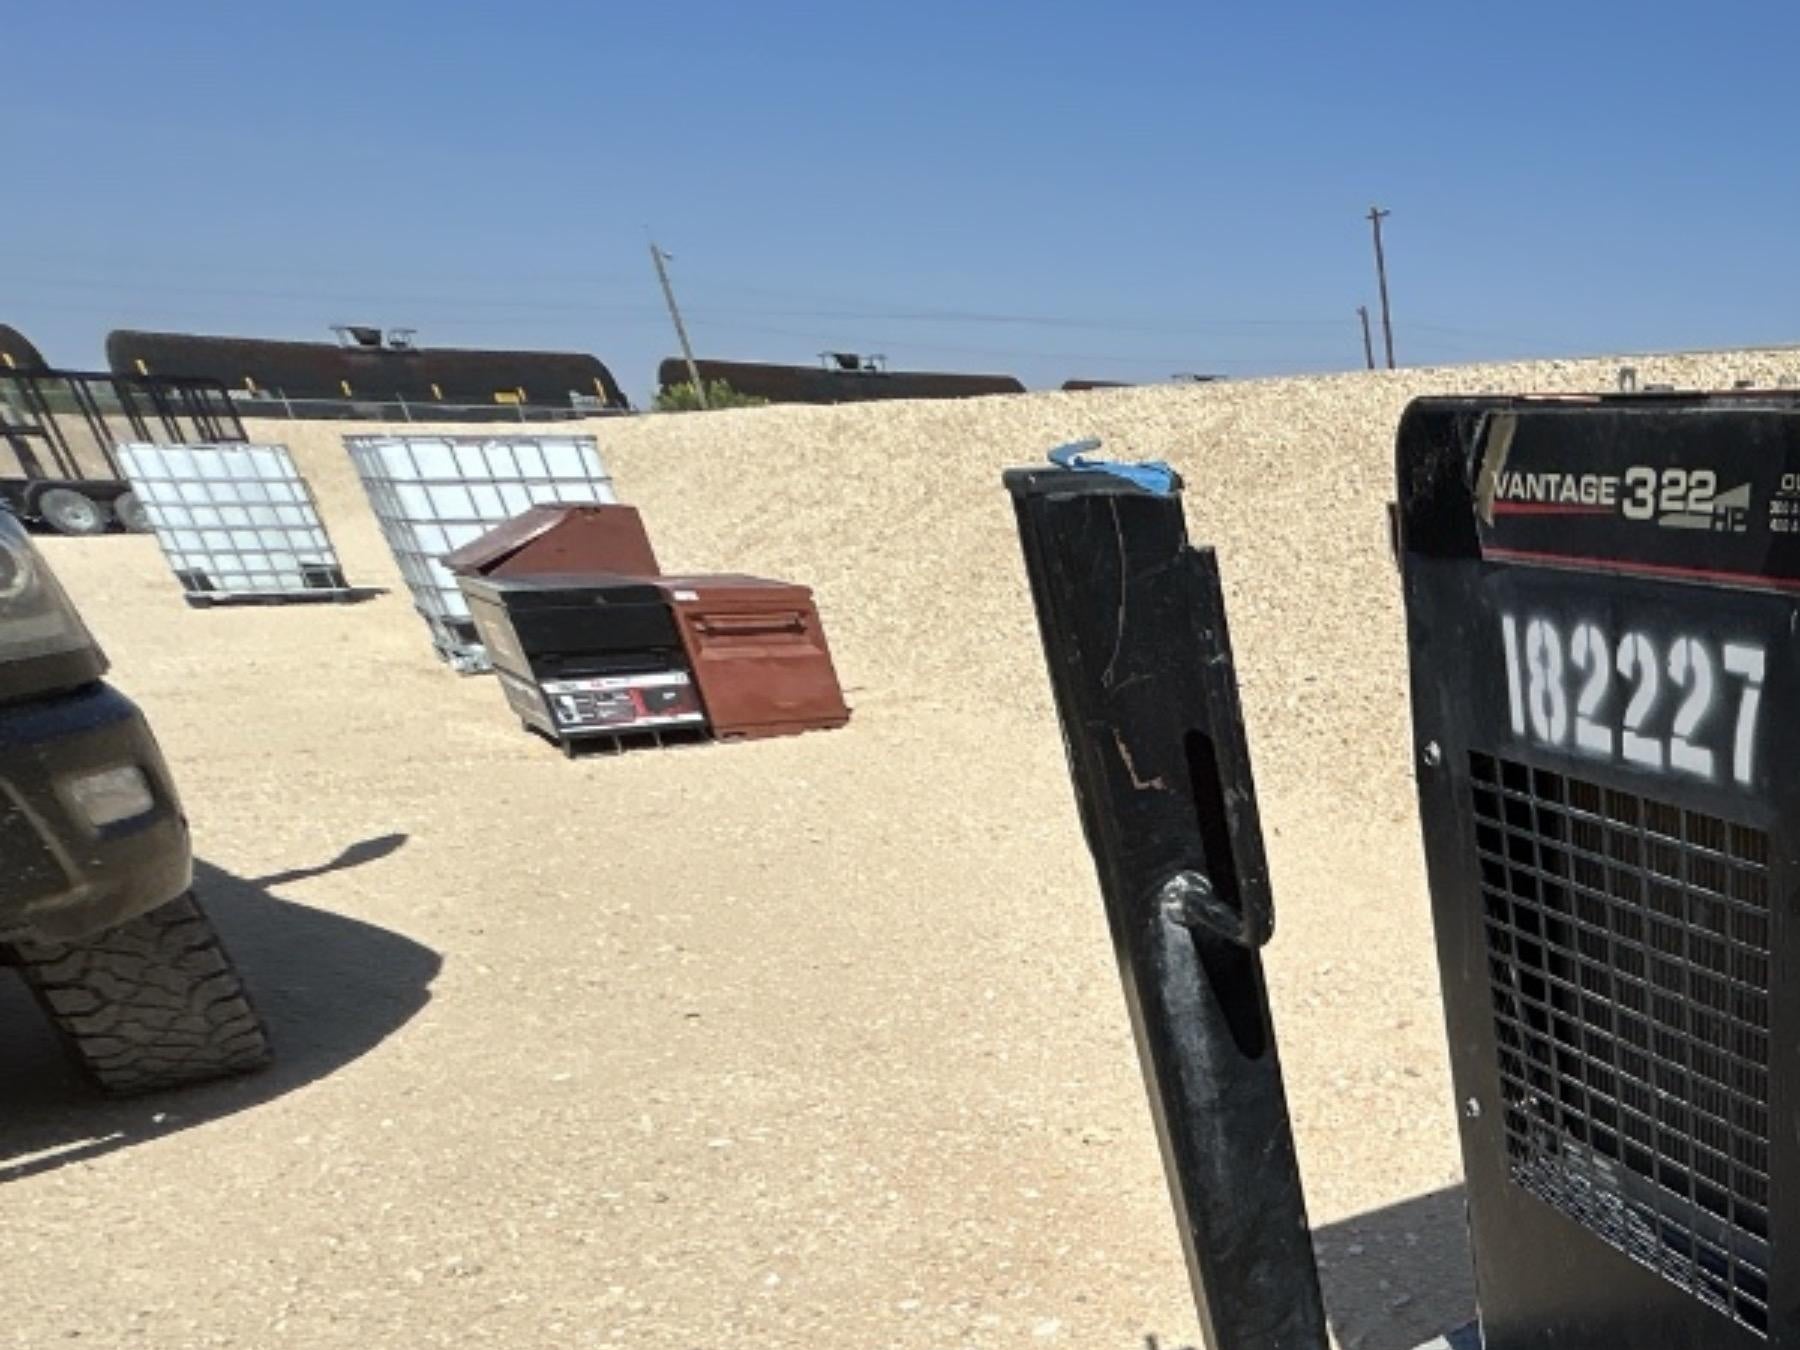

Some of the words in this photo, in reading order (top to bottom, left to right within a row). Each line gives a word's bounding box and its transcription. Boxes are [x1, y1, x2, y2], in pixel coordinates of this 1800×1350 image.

[1493, 470, 1620, 505] VANTAGE
[1621, 466, 1717, 520] 322
[1503, 612, 1766, 785] 182227
